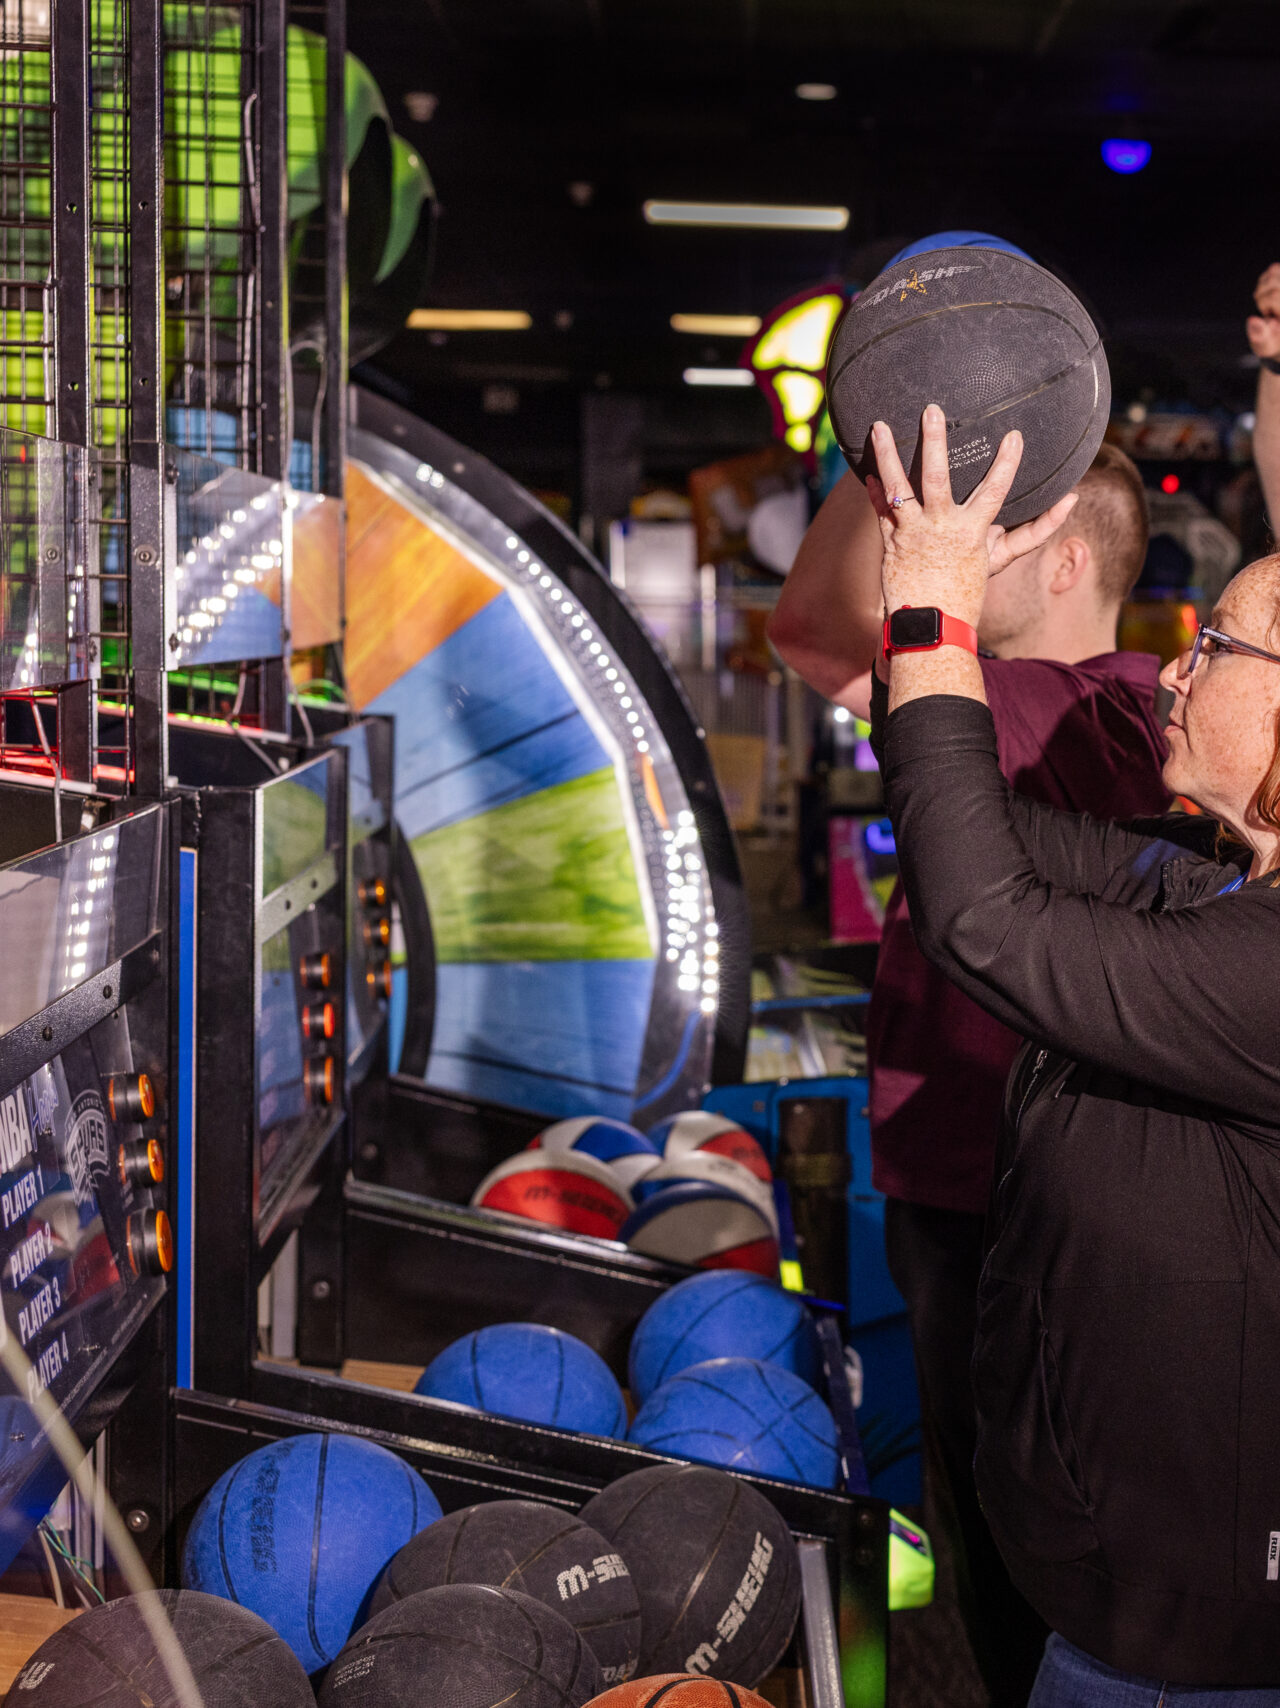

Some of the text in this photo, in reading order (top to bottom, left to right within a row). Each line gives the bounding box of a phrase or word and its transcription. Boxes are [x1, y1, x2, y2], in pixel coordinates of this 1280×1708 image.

[0, 1087, 32, 1175] NBA
[2, 1164, 45, 1228] PLAYER 1
[10, 1222, 54, 1289] PLAYER 2
[18, 1282, 54, 1345] PLAYER
[52, 1276, 62, 1309] 3
[27, 1339, 63, 1404] PLAYER
[61, 1331, 70, 1362] 4
